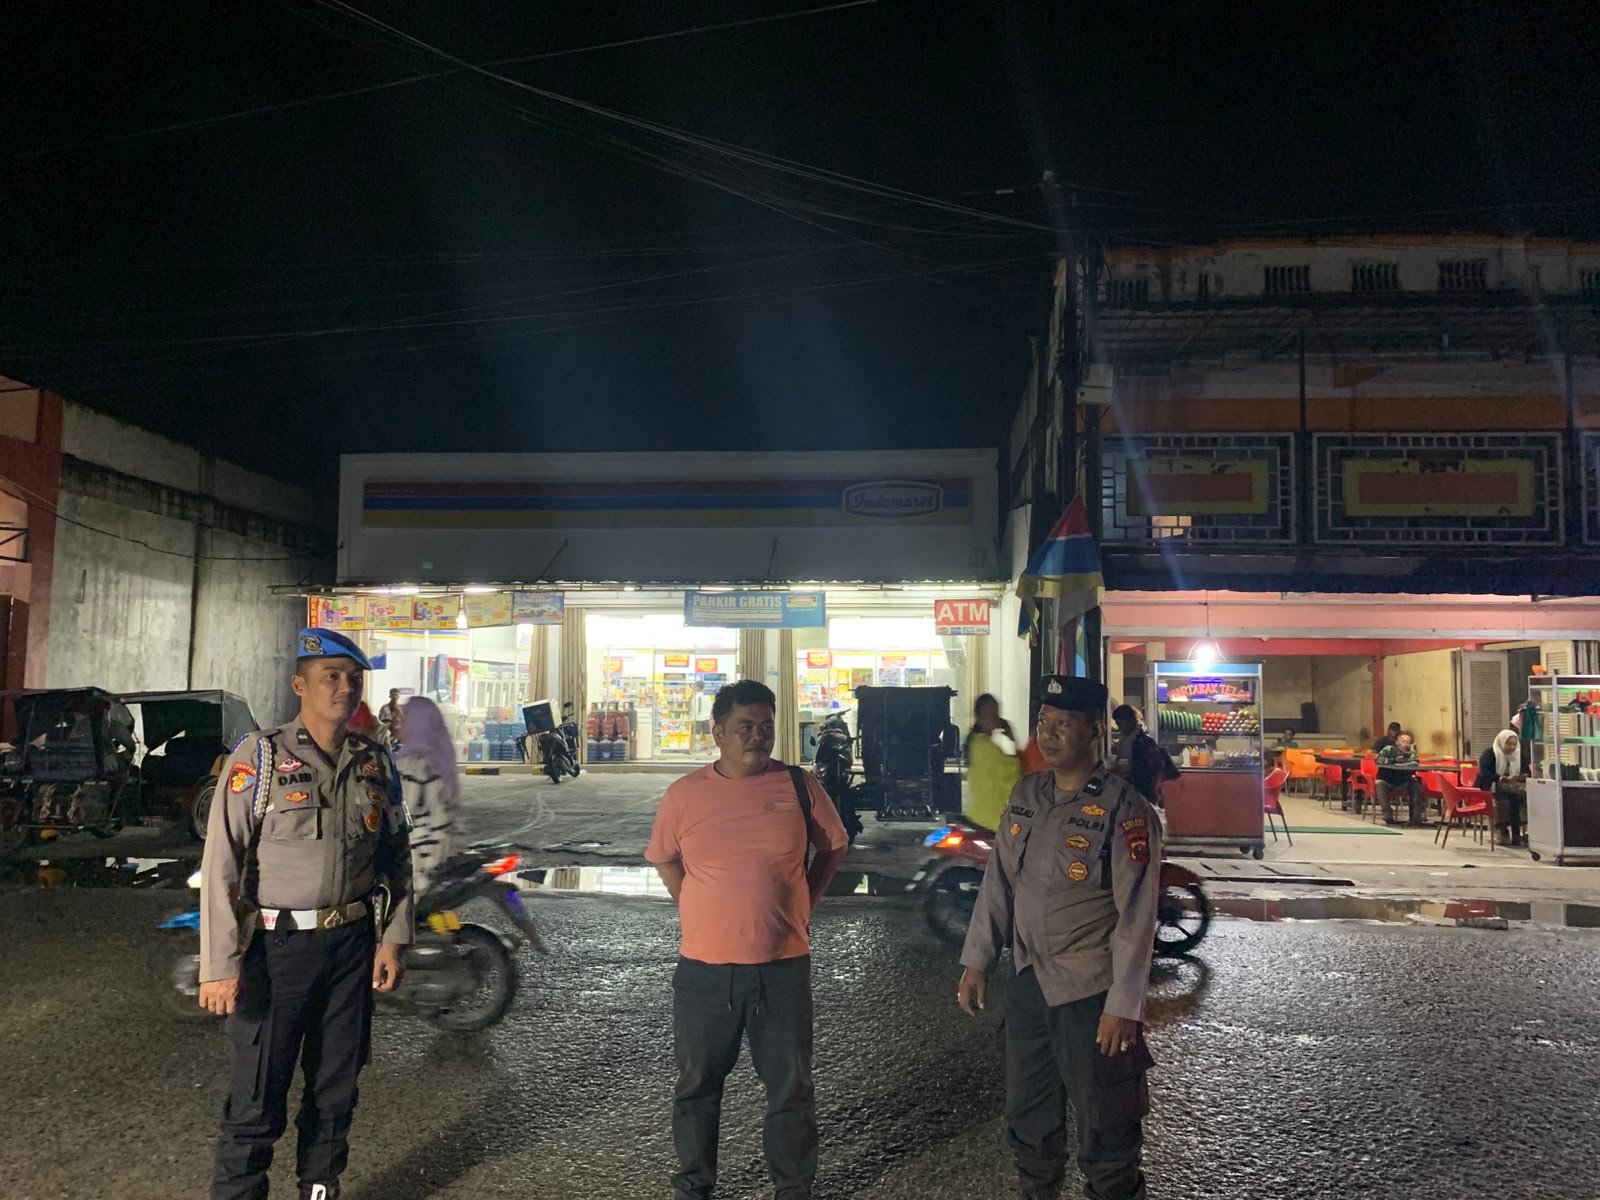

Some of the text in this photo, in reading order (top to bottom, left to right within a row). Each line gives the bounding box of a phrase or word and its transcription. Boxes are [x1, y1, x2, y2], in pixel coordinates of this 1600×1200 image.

[693, 595, 737, 608] PARKIR
[740, 595, 782, 608] GRATIS
[937, 602, 988, 621] ATM
[1067, 816, 1105, 832] POLRI
